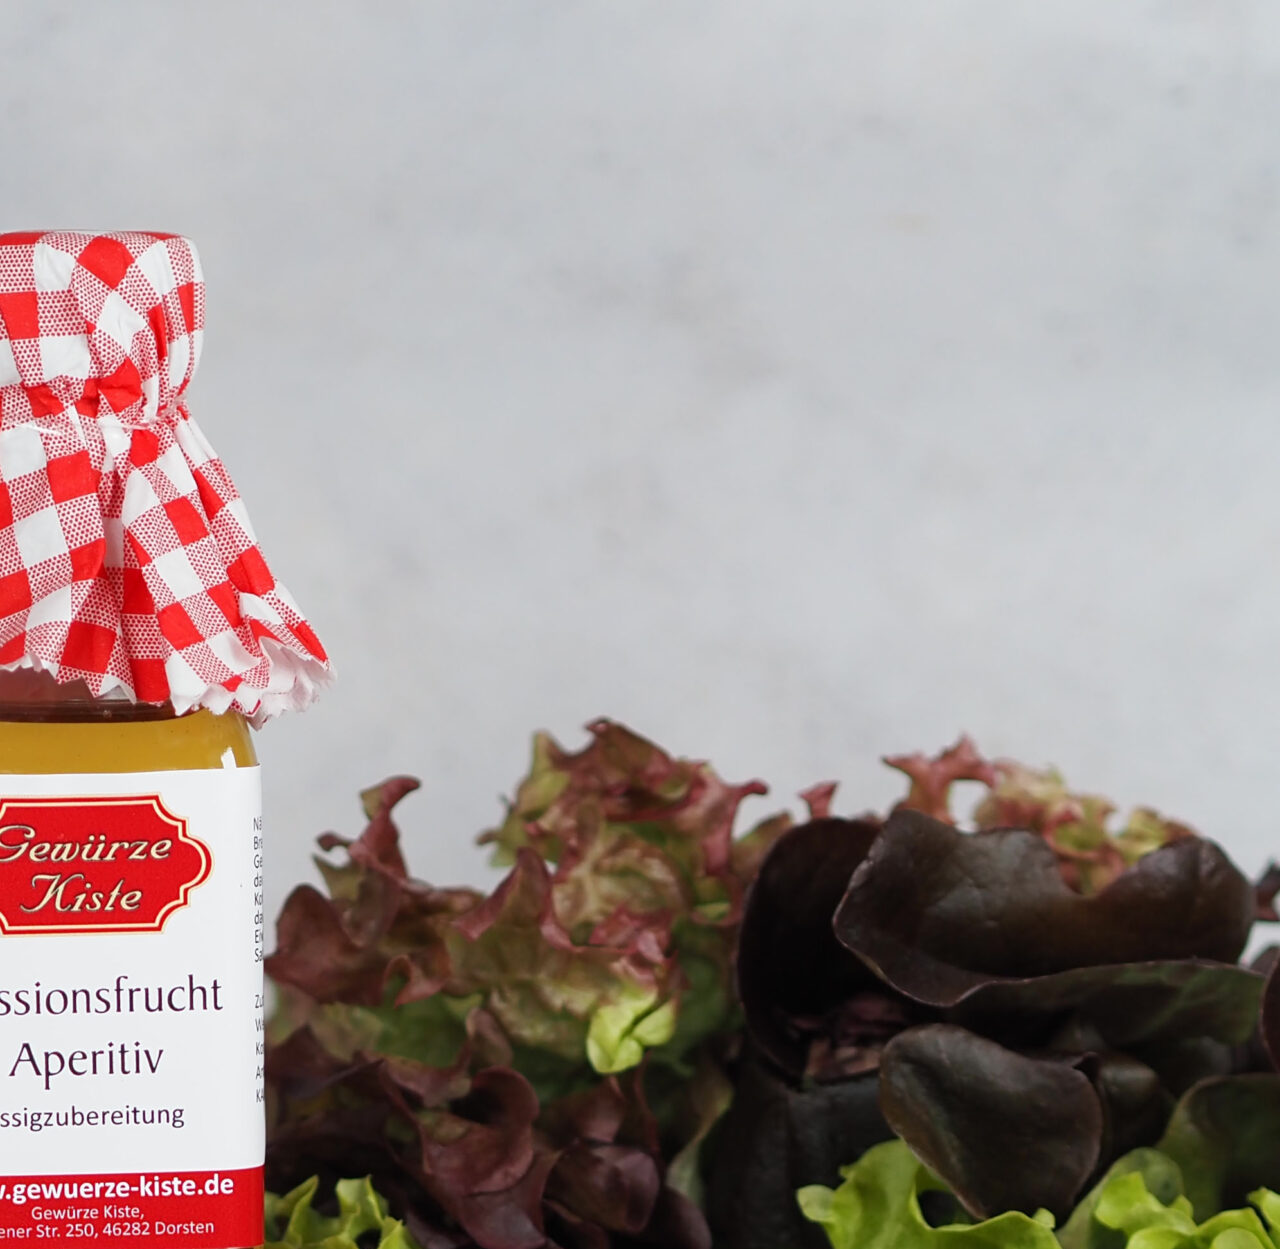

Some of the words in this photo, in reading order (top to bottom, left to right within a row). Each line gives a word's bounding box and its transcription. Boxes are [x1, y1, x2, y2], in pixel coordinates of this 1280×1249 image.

[20, 873, 143, 913] Kiste
[8, 1041, 164, 1090] Aperitiv
[31, 1205, 99, 1220] Gewürze
[103, 1204, 145, 1219] Kiste,
[36, 1224, 61, 1238] Str.
[65, 1222, 99, 1239] 250,
[102, 1222, 151, 1236] 46282
[155, 1221, 215, 1235] Dorsten
